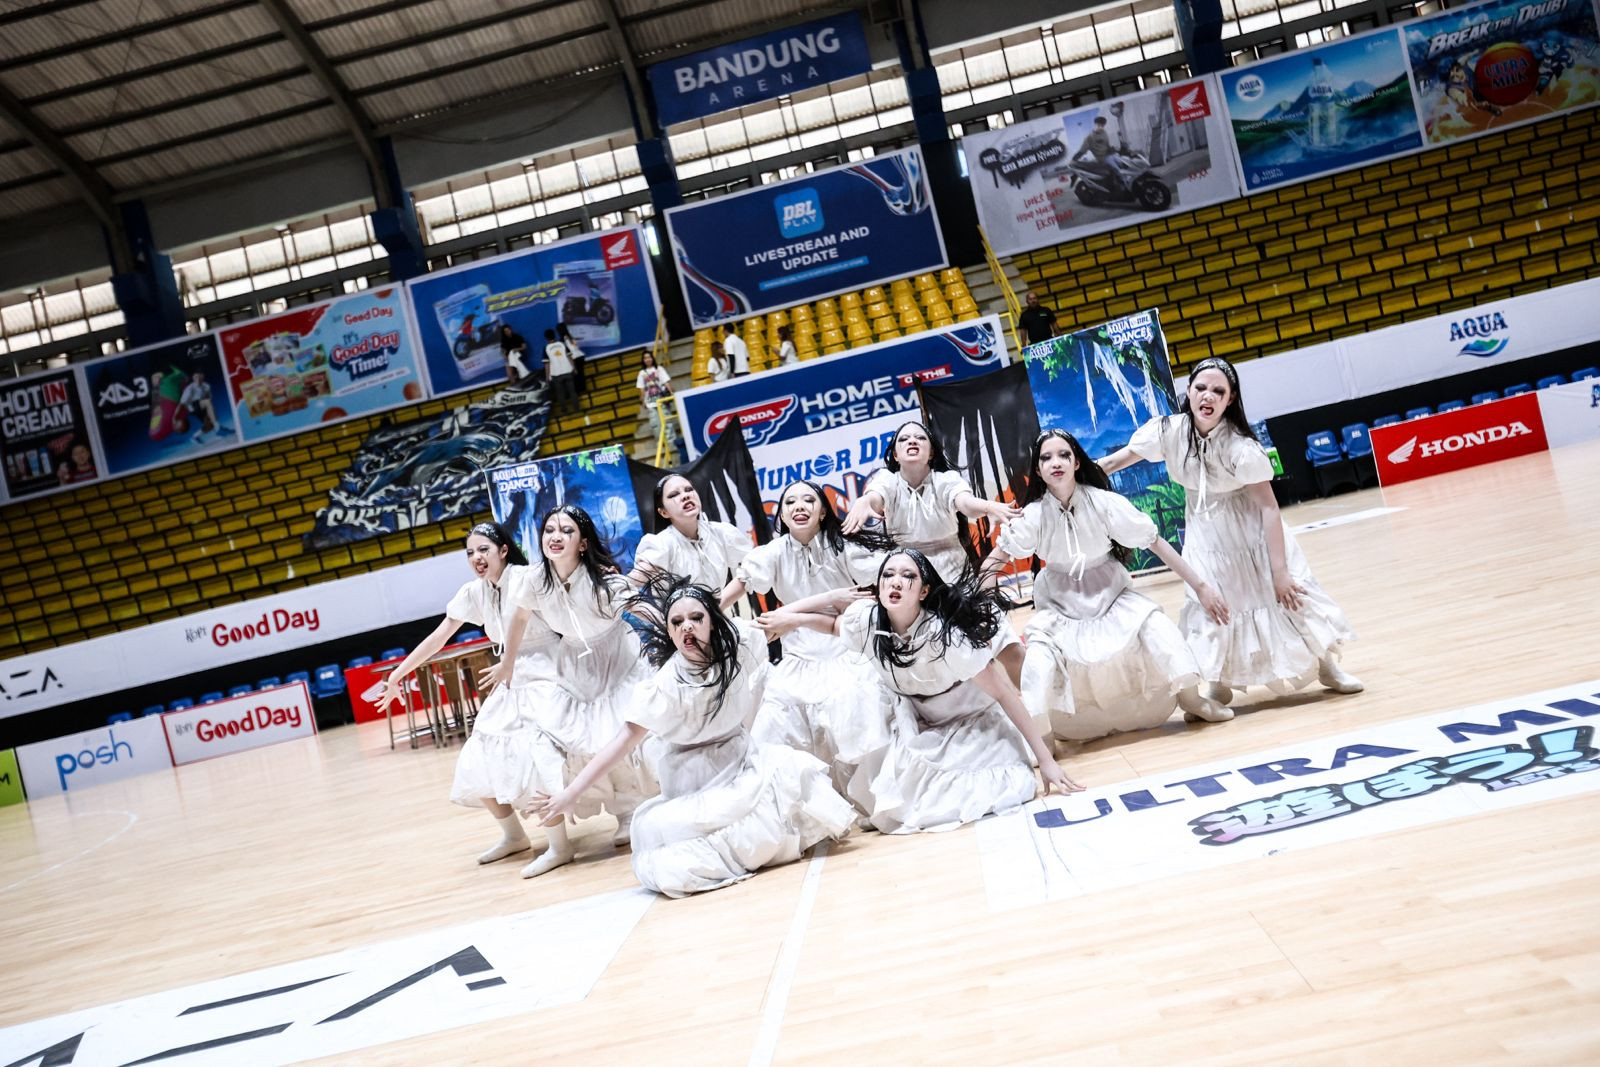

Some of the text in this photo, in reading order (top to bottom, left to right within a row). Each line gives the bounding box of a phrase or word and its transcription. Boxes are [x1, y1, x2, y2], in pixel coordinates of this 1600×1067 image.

[1428, 0, 1567, 59] BREAK THE DOUBT
[674, 27, 840, 94] BANDUNG
[1485, 55, 1530, 79] ULTRA
[709, 66, 819, 105] ARENA
[1239, 79, 1262, 92] AQUA
[1311, 86, 1333, 94] AQUA
[1492, 71, 1528, 89] MILK
[1017, 154, 1038, 168] MAKIN
[782, 200, 816, 222] DBL
[783, 214, 817, 230] PLAY
[744, 225, 870, 267] LIVESTREAM AND
[782, 247, 839, 271] UPDATE
[344, 310, 371, 325] Good
[371, 306, 394, 318] Day
[1107, 320, 1131, 336] AQUA
[1449, 311, 1508, 342] AQUA
[331, 331, 400, 365] Good Day
[348, 348, 389, 375] Time!
[1030, 343, 1054, 359] AQUA
[0, 381, 68, 418] HOT IN
[800, 375, 895, 414] HOME
[923, 367, 947, 379] THE
[1, 404, 73, 438] CREAM
[740, 408, 776, 424] ONDA
[804, 389, 920, 433] DREAM
[1419, 421, 1533, 458] HONDA
[594, 451, 620, 465] AQUA
[492, 468, 517, 482] AQUA
[211, 612, 271, 648] Good
[272, 608, 320, 633] Day
[195, 710, 255, 743] Good
[254, 705, 302, 729] Day
[55, 728, 133, 791] posh
[1033, 692, 1600, 829] ULTRA MI
